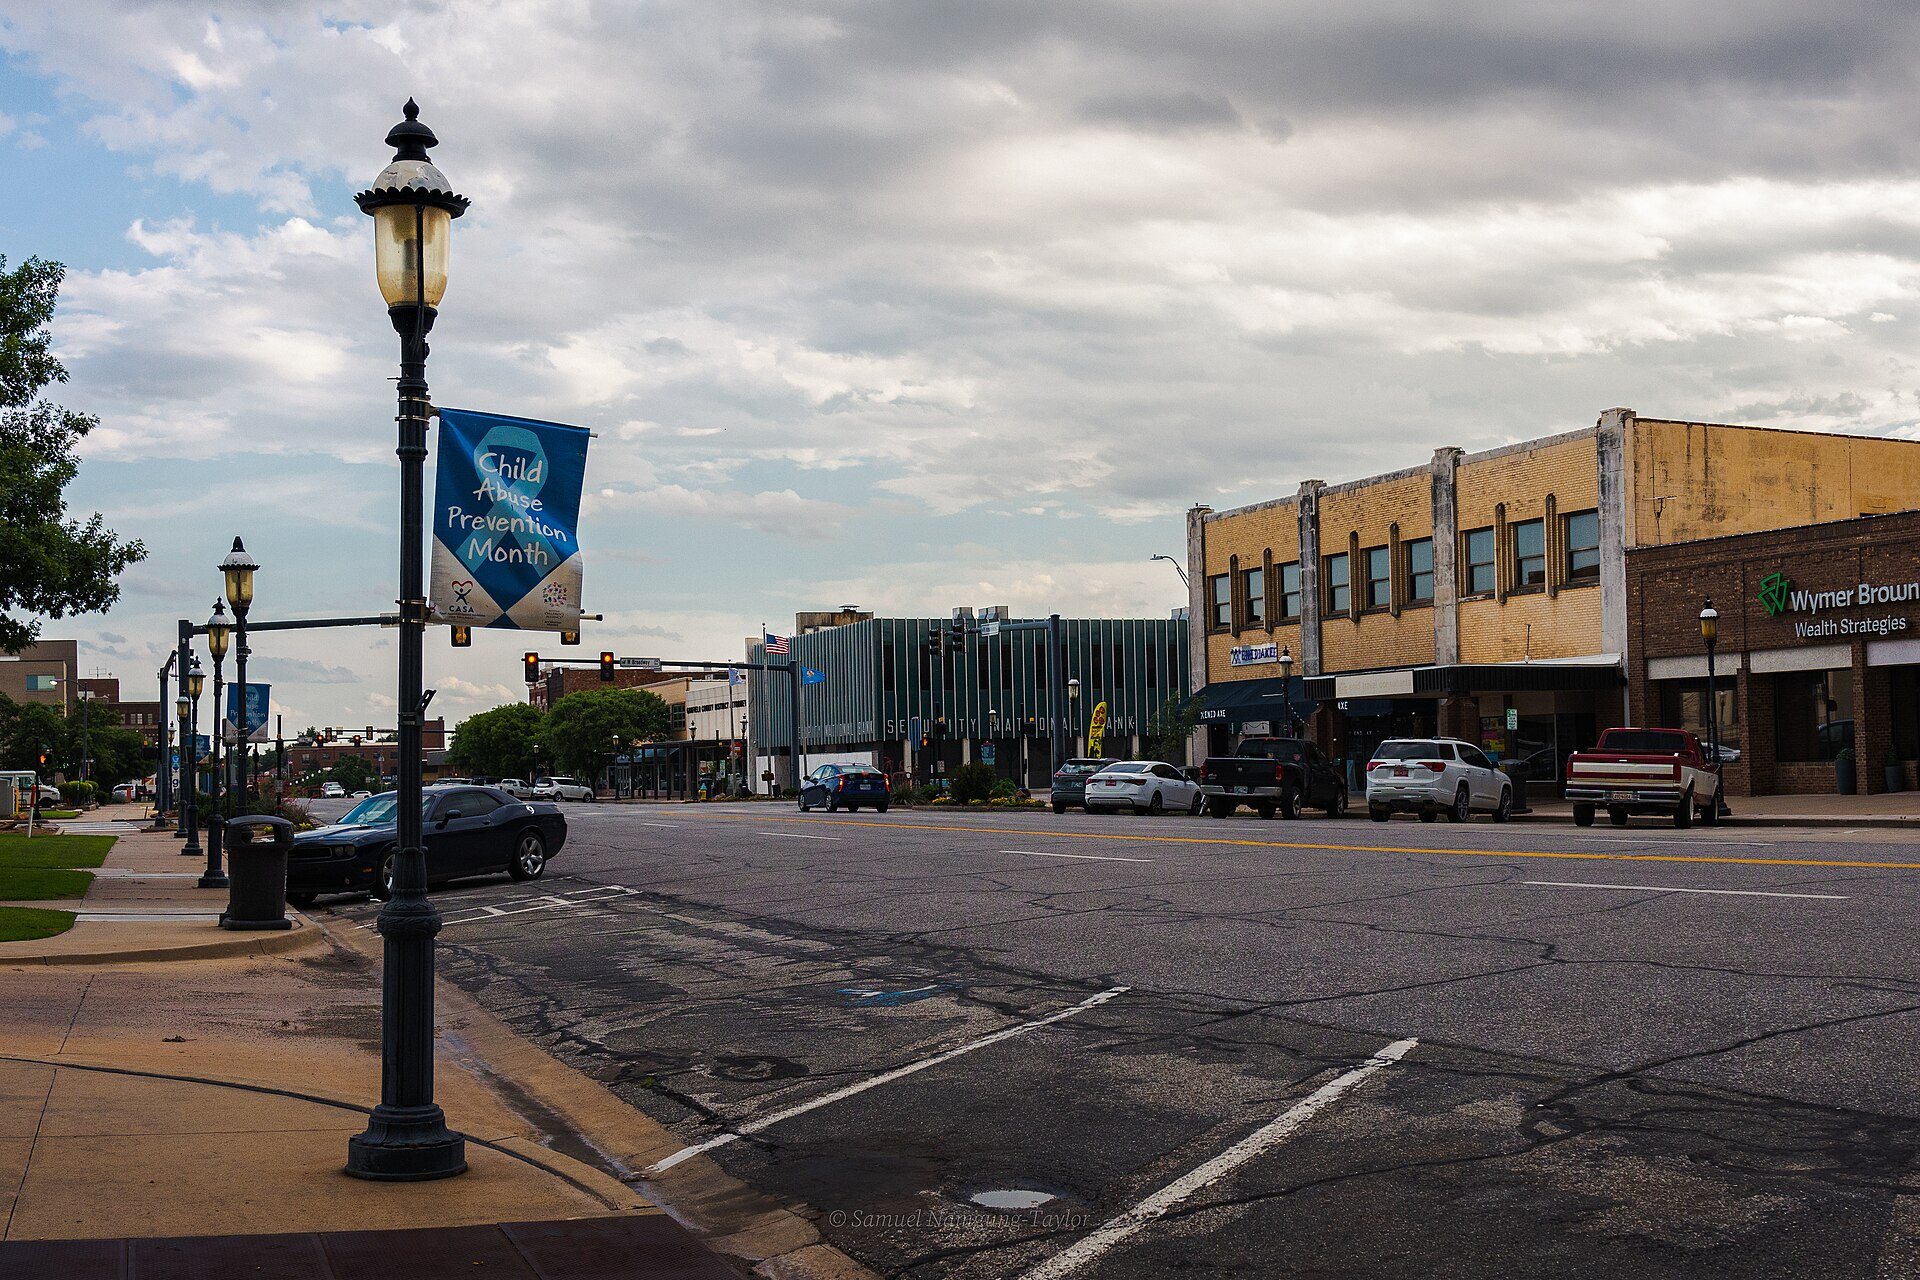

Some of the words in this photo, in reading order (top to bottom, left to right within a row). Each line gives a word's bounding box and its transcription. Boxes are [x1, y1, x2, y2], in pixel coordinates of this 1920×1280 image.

[478, 452, 543, 484] Child
[473, 477, 544, 512] Abuse
[447, 506, 567, 542] Prevention
[468, 537, 549, 566] Month
[448, 605, 475, 613] CASA
[1790, 588, 1854, 615] Wymer
[1858, 582, 1920, 605] Brown
[1795, 619, 1838, 638] Wealth
[1840, 615, 1906, 635] Strategies
[730, 699, 747, 709] TTORNEY
[887, 718, 977, 734] SEUITY
[993, 717, 1079, 732] NATONAL
[1104, 716, 1135, 730] ANK
